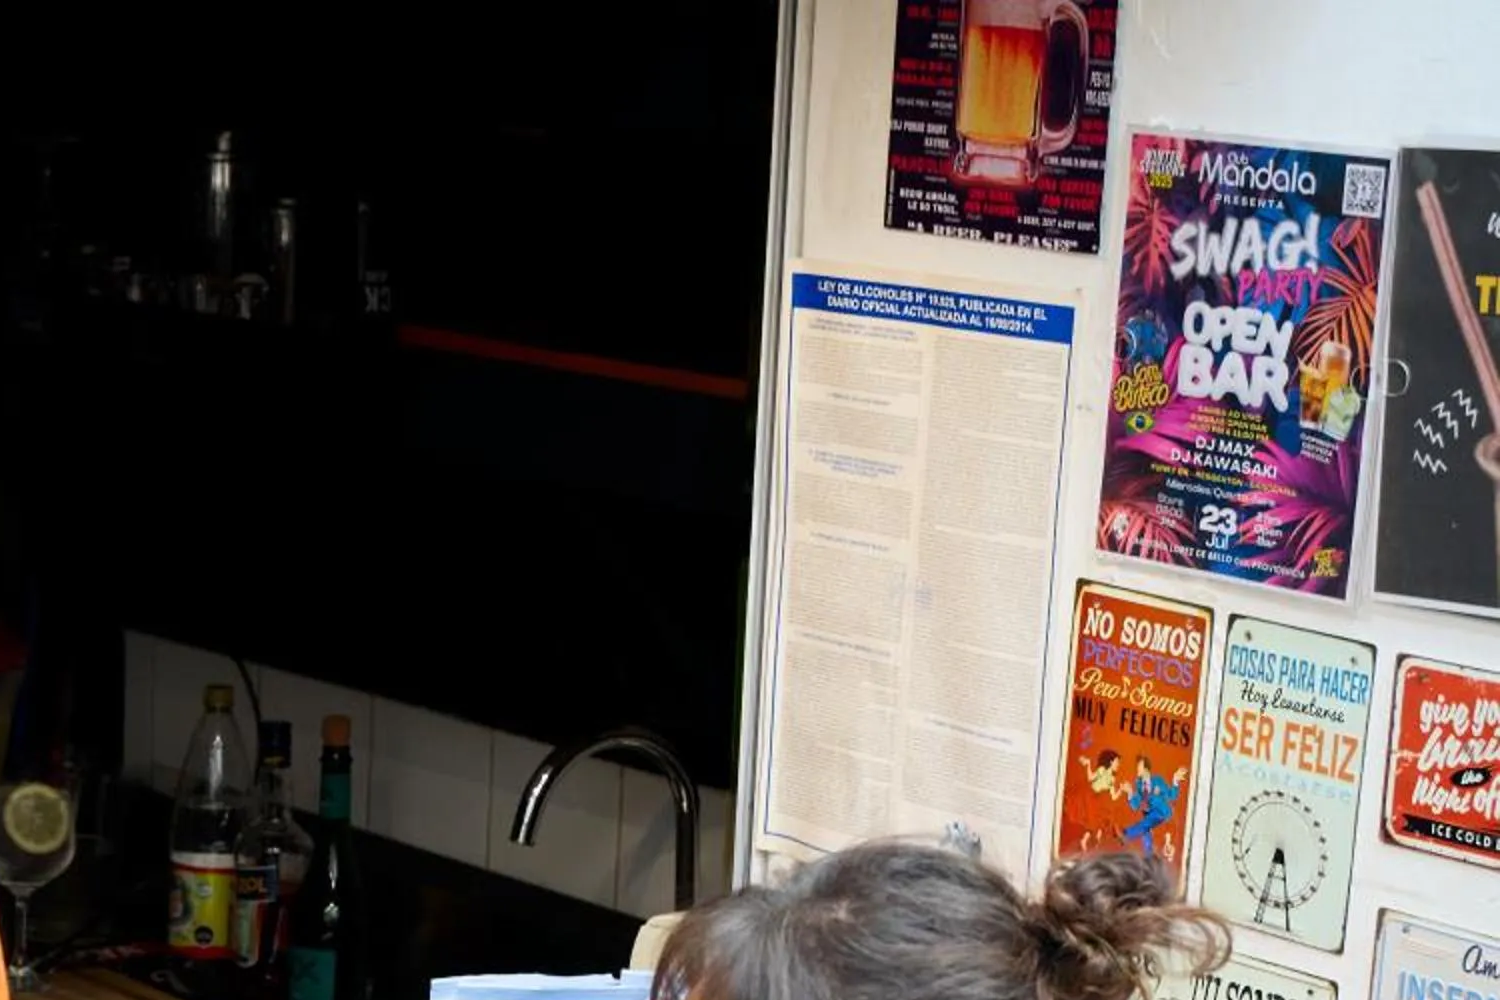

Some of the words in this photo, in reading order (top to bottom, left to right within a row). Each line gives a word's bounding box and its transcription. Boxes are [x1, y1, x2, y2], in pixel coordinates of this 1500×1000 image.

[1198, 152, 1317, 195] Mandala
[1214, 193, 1285, 209] PRESENTA
[1169, 213, 1320, 281] SWAG!
[817, 280, 836, 293] LEY
[837, 282, 851, 295] DE
[852, 284, 914, 303] ALCOHOLES
[959, 297, 1015, 317] PUBLICADA
[1017, 305, 1032, 319] EN
[1033, 308, 1048, 321] EL
[1237, 267, 1326, 305] PARTY
[827, 295, 860, 311] DIARIO
[861, 299, 901, 316] OFICIAL
[902, 305, 967, 325] ACTUALIZADA
[969, 314, 983, 327] AL
[1182, 301, 1294, 361] OPEN
[1176, 343, 1289, 412] BAR
[1170, 450, 1191, 464] DJ
[1192, 452, 1278, 478] KAWASAKI
[1195, 436, 1214, 453] DJ
[1217, 440, 1256, 458] MAX
[1199, 504, 1238, 535] 23
[1205, 533, 1230, 550] Jul
[1083, 607, 1115, 640] NO
[1121, 617, 1201, 661] SOMOS
[1083, 639, 1193, 688] PERFECTOS
[1229, 644, 1277, 684] COSAS
[1279, 655, 1317, 694] PARA
[1320, 666, 1370, 704] HACER
[1074, 667, 1121, 701] Pero
[1129, 680, 1193, 717] Somos
[1240, 681, 1269, 712] Hoy
[1074, 696, 1108, 726] MUY
[1120, 708, 1191, 748] FELICES
[1222, 706, 1275, 762] SER
[1282, 722, 1359, 784] FELIZ
[1431, 823, 1452, 839] ICE
[1455, 829, 1492, 848] COLD
